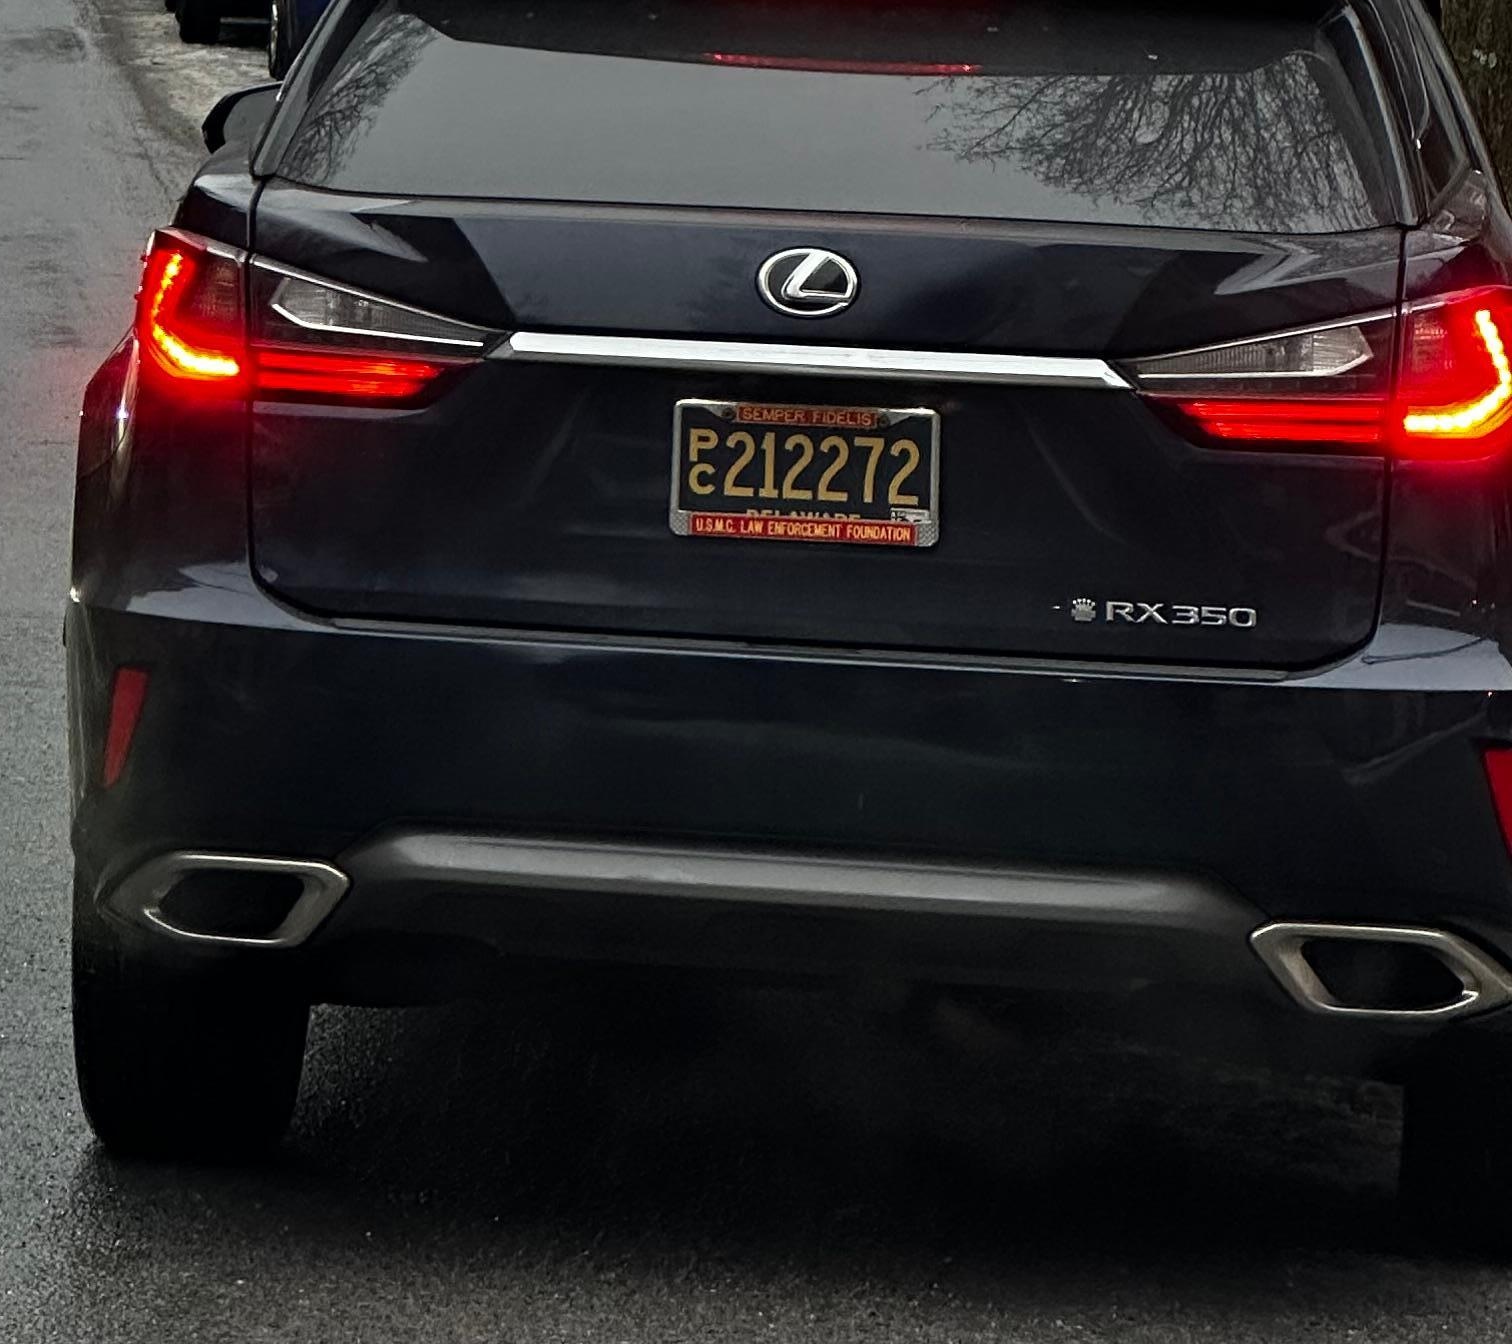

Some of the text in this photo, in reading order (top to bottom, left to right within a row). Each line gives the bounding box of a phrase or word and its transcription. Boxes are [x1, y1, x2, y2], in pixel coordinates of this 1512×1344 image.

[742, 407, 873, 426] SEMPER FIDELIS
[723, 430, 920, 506] 212272
[739, 520, 765, 534] LAW
[767, 521, 841, 538] ENFORCEMENT
[847, 524, 911, 542] FOUNDATION
